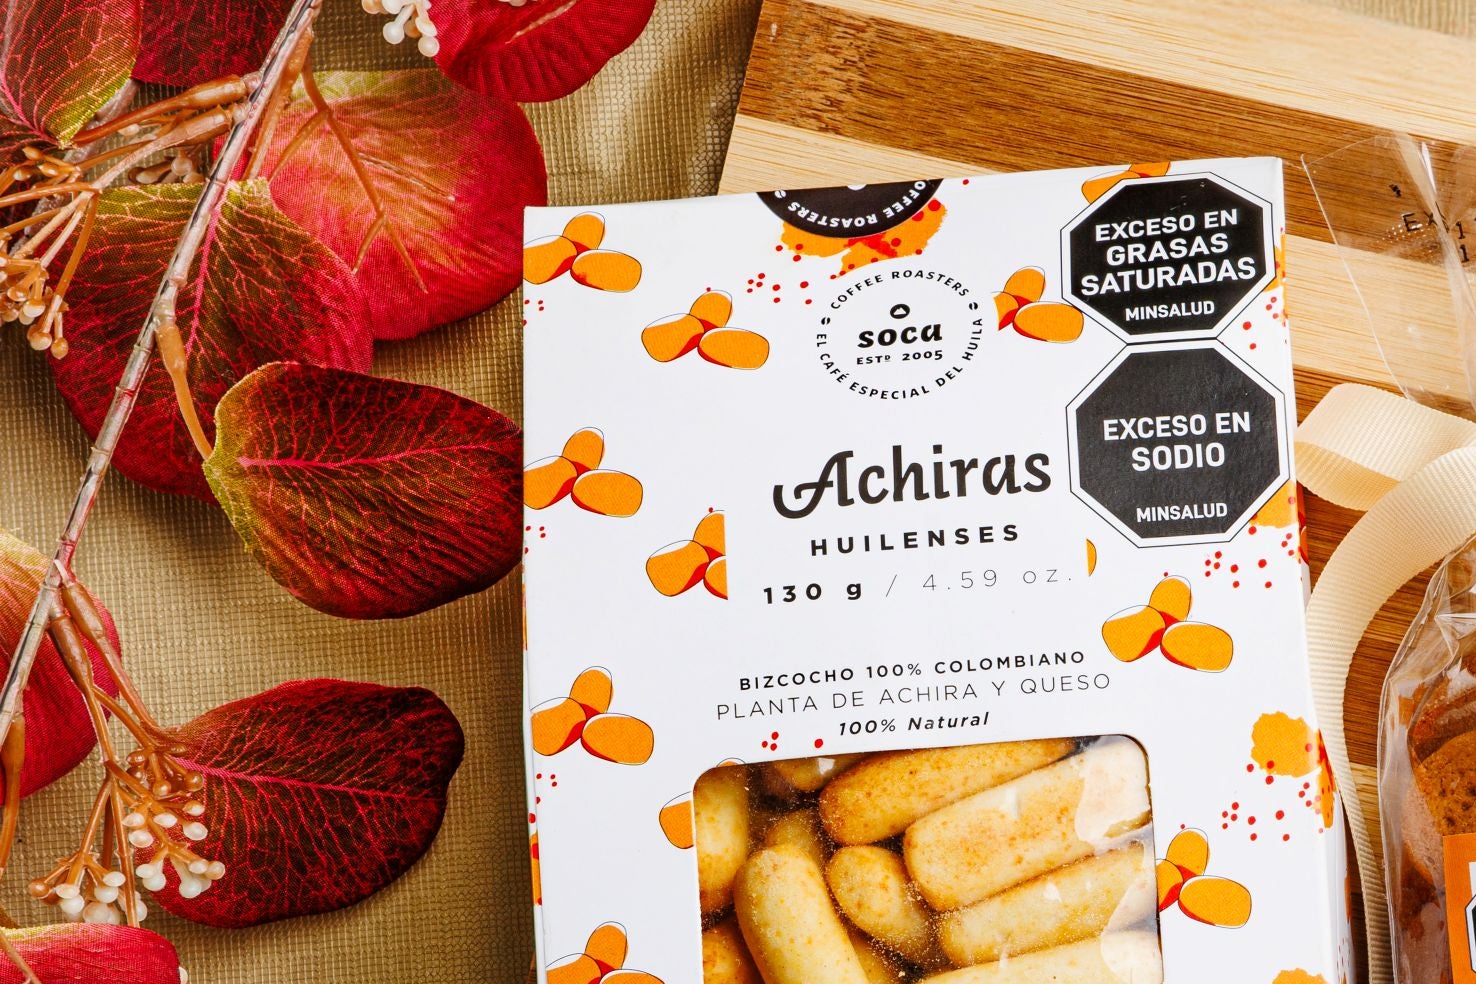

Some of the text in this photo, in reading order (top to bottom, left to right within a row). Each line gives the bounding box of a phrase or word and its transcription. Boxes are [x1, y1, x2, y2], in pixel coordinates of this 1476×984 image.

[787, 180, 927, 228] OFFEE ROASTERS
[1095, 208, 1238, 242] EXCESO EN
[1106, 233, 1229, 267] GRASAS
[830, 269, 969, 309] COFFEE ROASTERS
[1081, 257, 1256, 296] SATURADAS
[1125, 301, 1215, 322] MINSALUD
[857, 323, 943, 349] soca
[816, 318, 983, 400] EL CAFÉ ESPECIAL DEL HUILA
[902, 350, 944, 361] 2005
[1103, 411, 1251, 441] EXCESO EN
[1131, 442, 1225, 472] SODIO
[772, 444, 1051, 519] Achiras
[1136, 502, 1228, 523] MINSALUD
[810, 524, 1019, 557] HUILENSES
[763, 568, 1072, 604] 130 g / 4.59 oz.
[739, 650, 1086, 691] BIZCOCHO 100% COLOMBIANO
[716, 673, 1111, 720] PLANTA DE ACHIRA Y QUESO
[838, 711, 989, 736] 100% Natural
